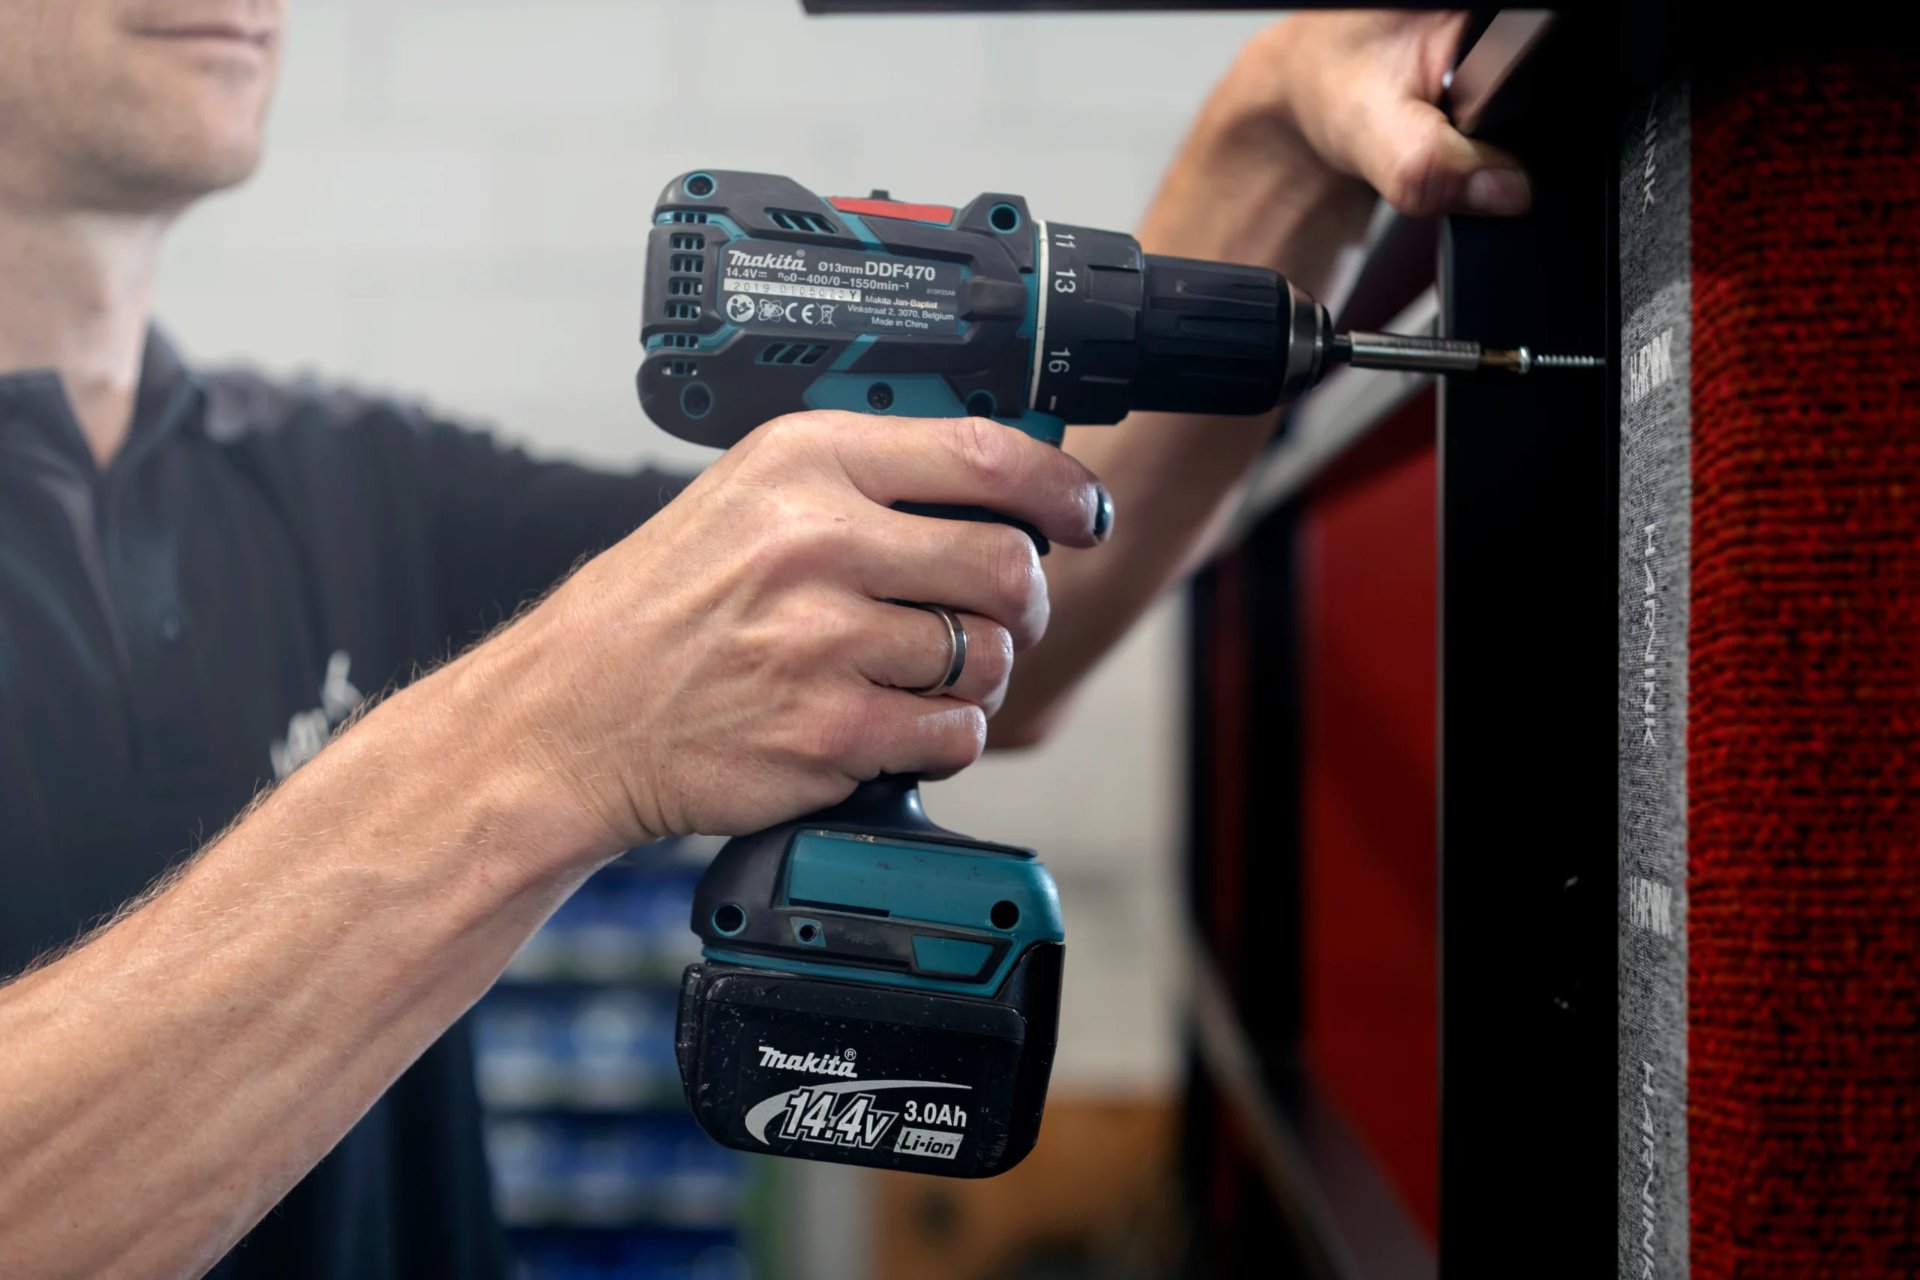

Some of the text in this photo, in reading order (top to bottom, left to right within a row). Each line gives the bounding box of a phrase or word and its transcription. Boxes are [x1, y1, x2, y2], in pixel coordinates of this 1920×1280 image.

[1055, 233, 1077, 249] 11
[864, 260, 936, 281] DDF470
[734, 281, 770, 294] 2019
[848, 290, 859, 301] Y
[1054, 268, 1077, 294] 13
[865, 294, 939, 310] Makita Jan-Baptist
[847, 304, 888, 317] Vinkstraat
[921, 312, 955, 323] Belgium
[871, 316, 894, 327] Made
[904, 320, 929, 330] China
[1048, 348, 1072, 374] 16
[903, 1100, 968, 1128] 3.0Ah
[901, 1130, 955, 1157] Li-ion
